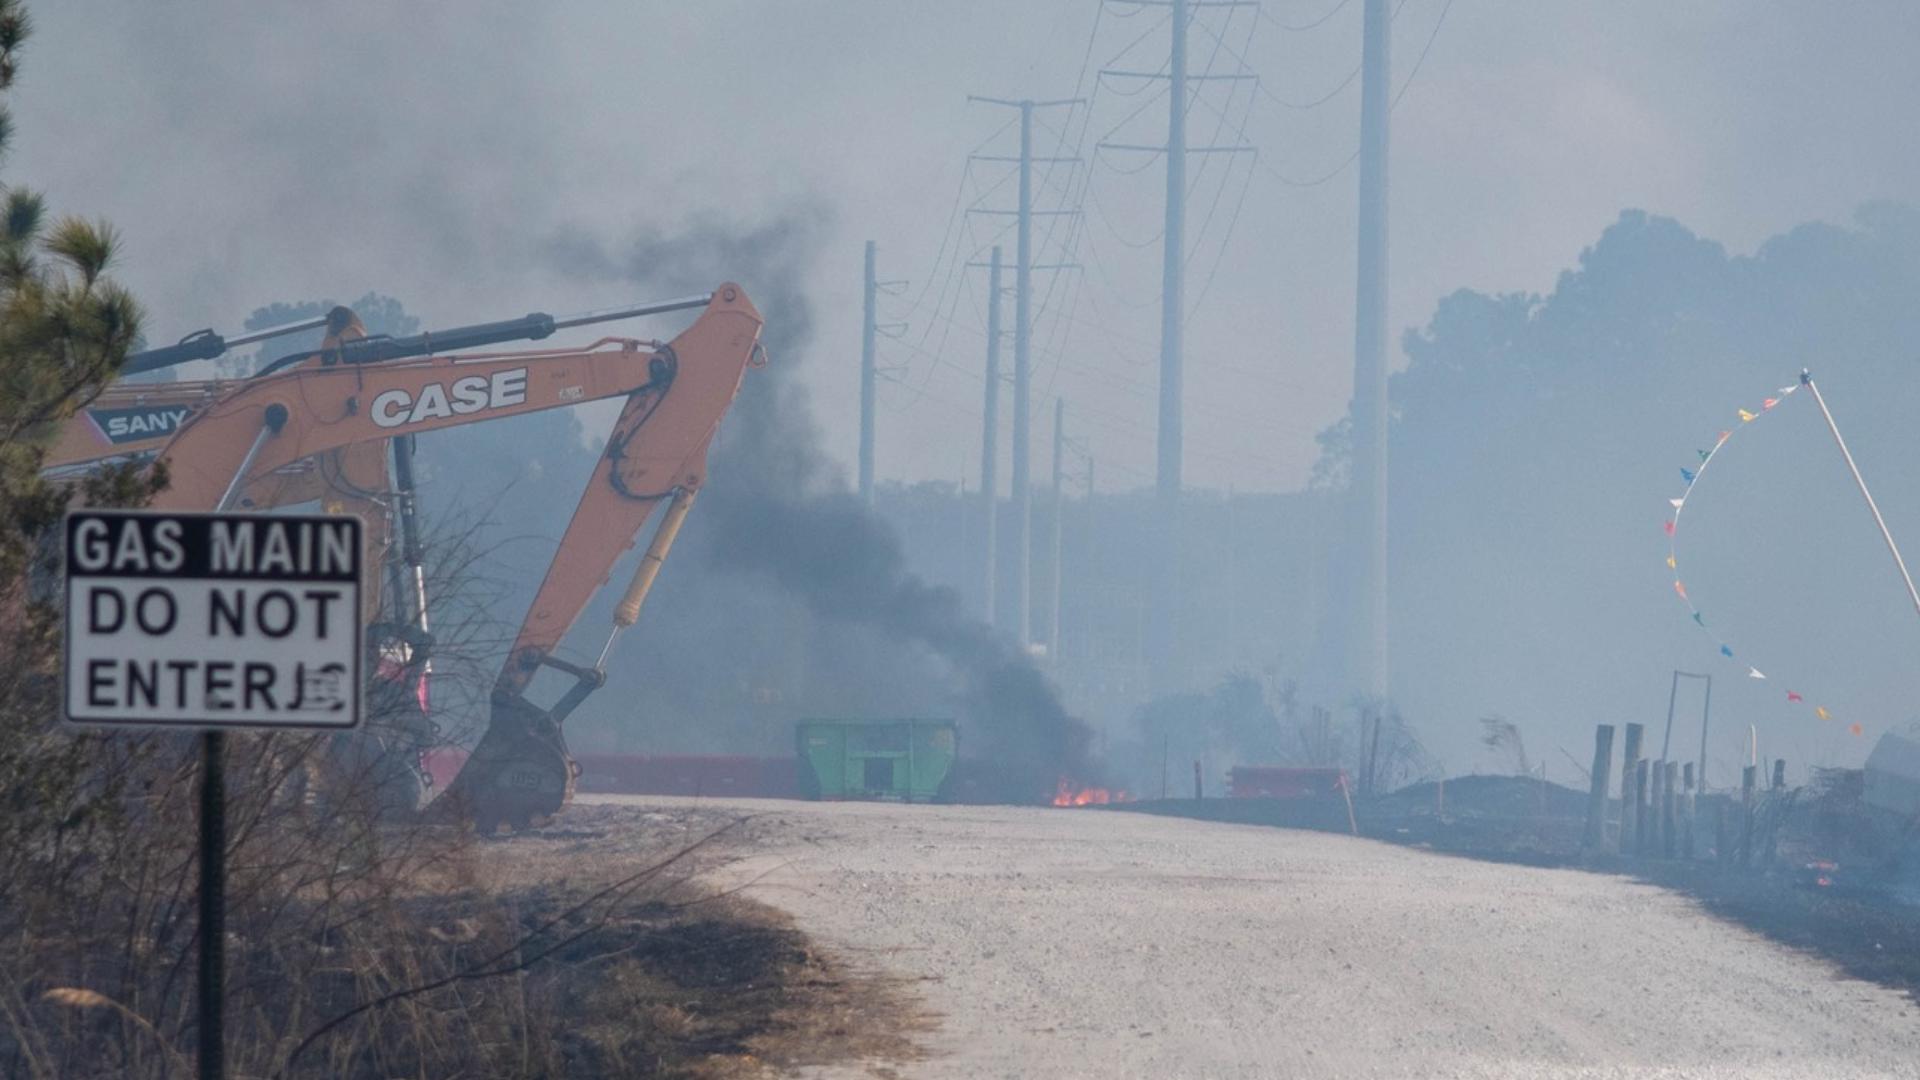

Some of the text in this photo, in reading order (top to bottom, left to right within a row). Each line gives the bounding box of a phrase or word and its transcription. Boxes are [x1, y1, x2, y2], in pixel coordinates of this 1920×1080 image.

[108, 410, 187, 436] SANY
[370, 367, 528, 428] CASE
[74, 518, 353, 574] GAS MAIN
[88, 586, 342, 640] DO NOT
